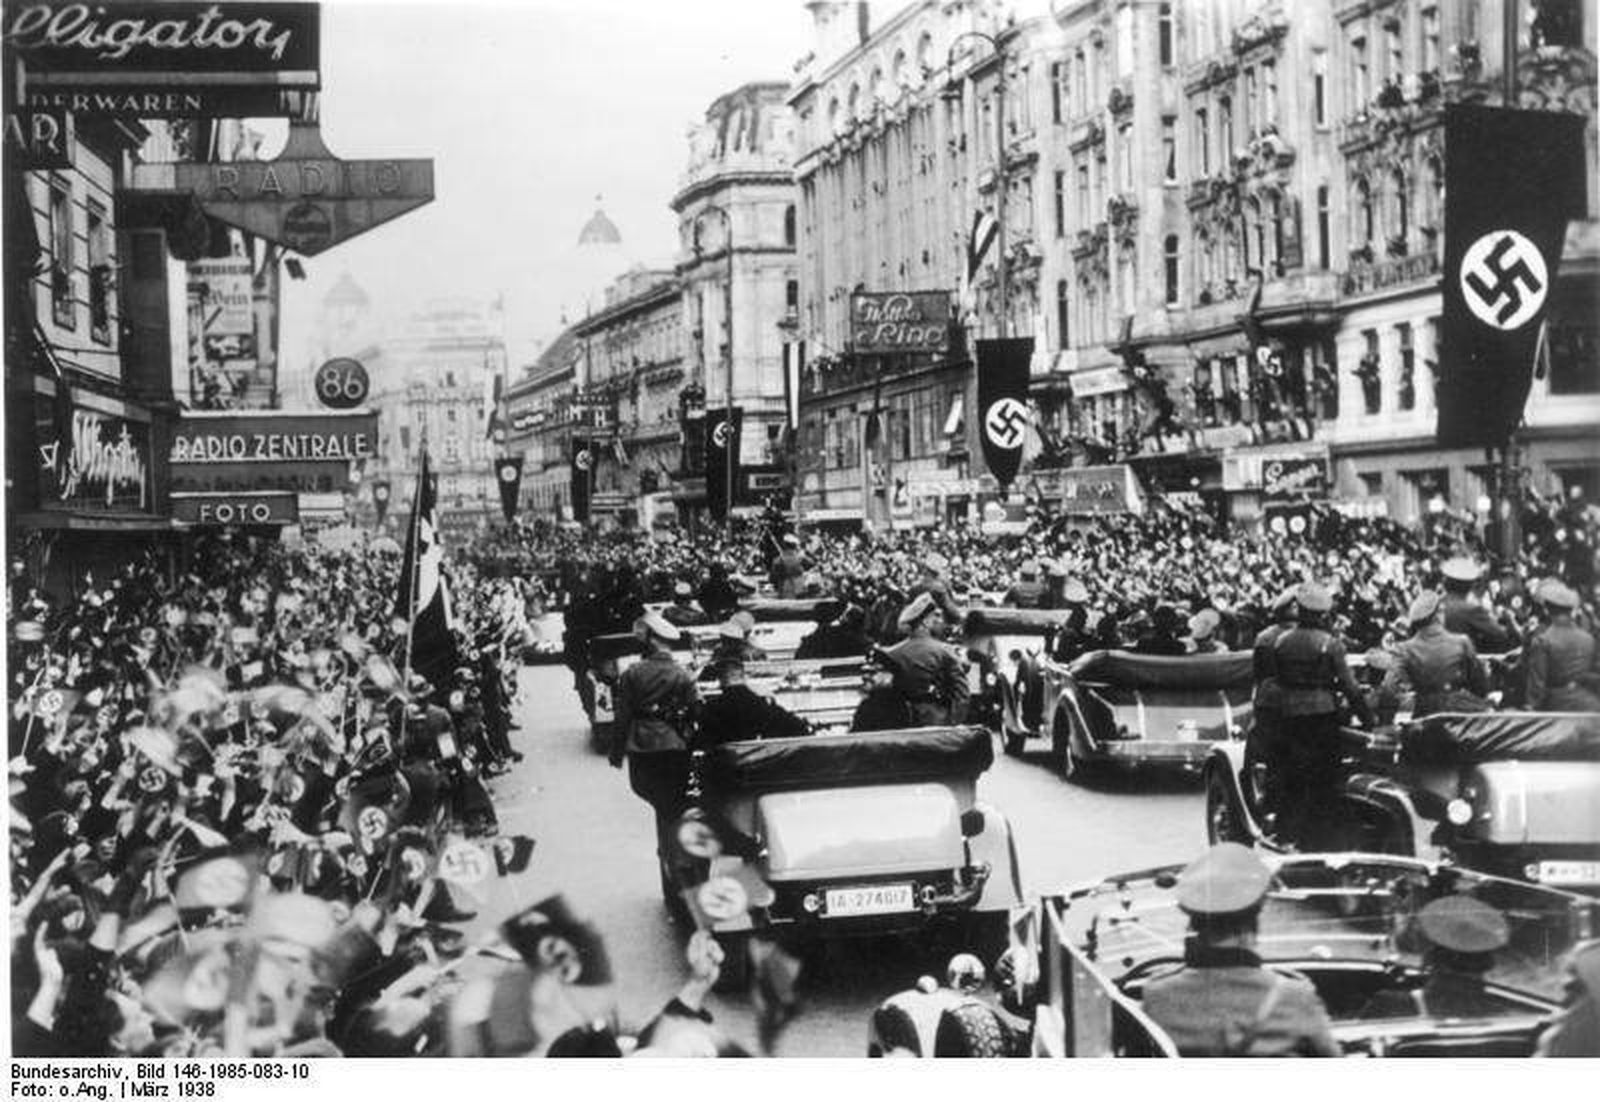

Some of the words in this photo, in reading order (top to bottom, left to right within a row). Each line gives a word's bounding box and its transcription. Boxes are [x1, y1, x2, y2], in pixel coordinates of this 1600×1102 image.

[6, 3, 292, 60] lligator
[215, 162, 402, 201] RADIO
[321, 368, 363, 399] 86
[174, 435, 246, 460] RADIO
[253, 433, 369, 460] ZENTRALE
[200, 503, 271, 522] FOTO
